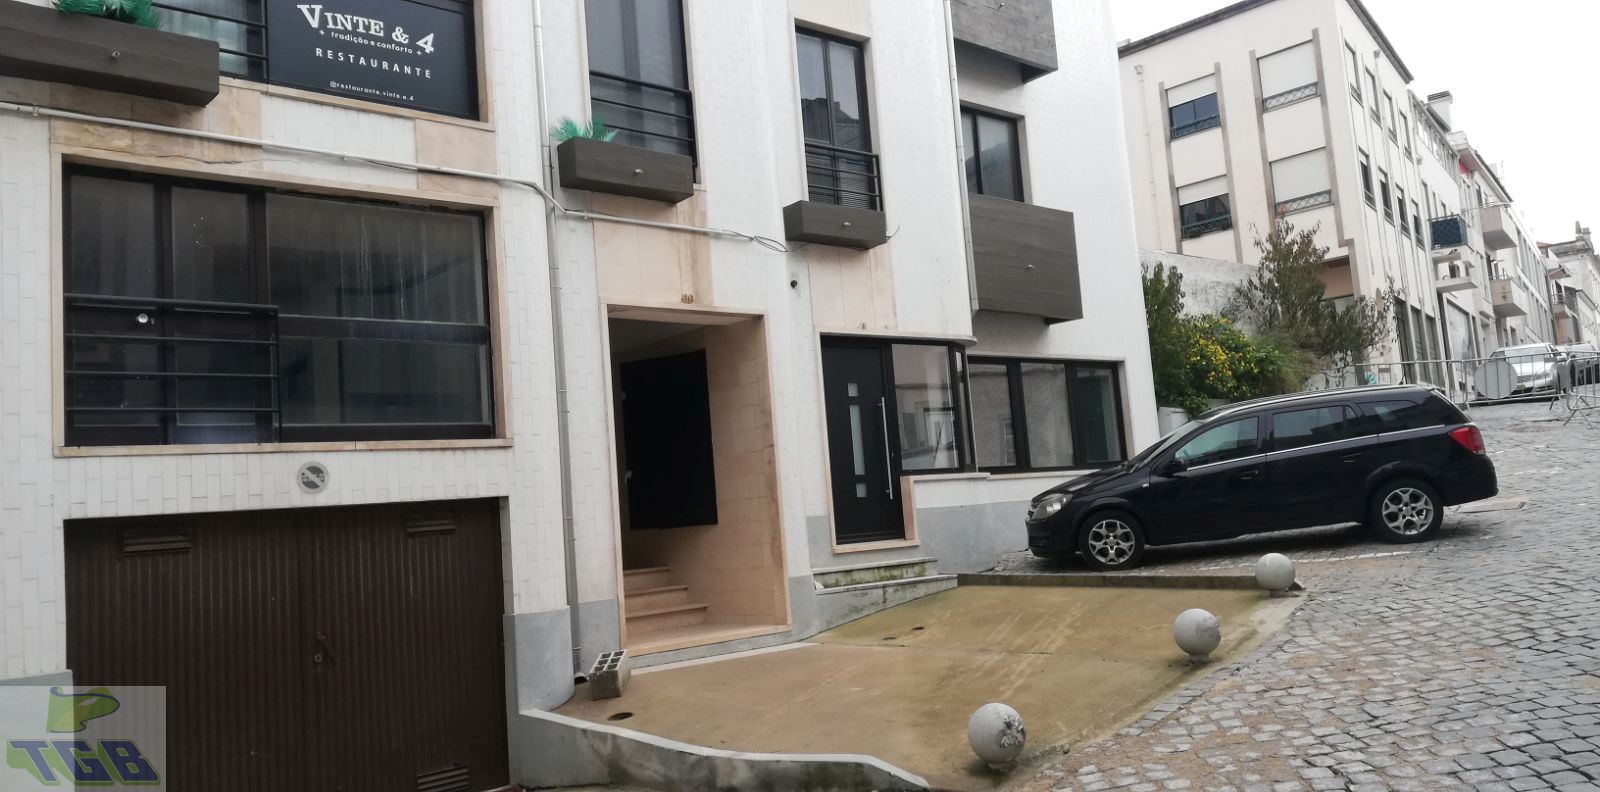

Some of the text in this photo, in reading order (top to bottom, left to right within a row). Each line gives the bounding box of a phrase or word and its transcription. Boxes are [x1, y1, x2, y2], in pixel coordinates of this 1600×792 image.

[331, 32, 368, 45] tradição
[376, 42, 412, 54] conforto
[391, 26, 408, 44] &
[416, 33, 435, 54] 4
[316, 47, 432, 79] RESTAURANTE
